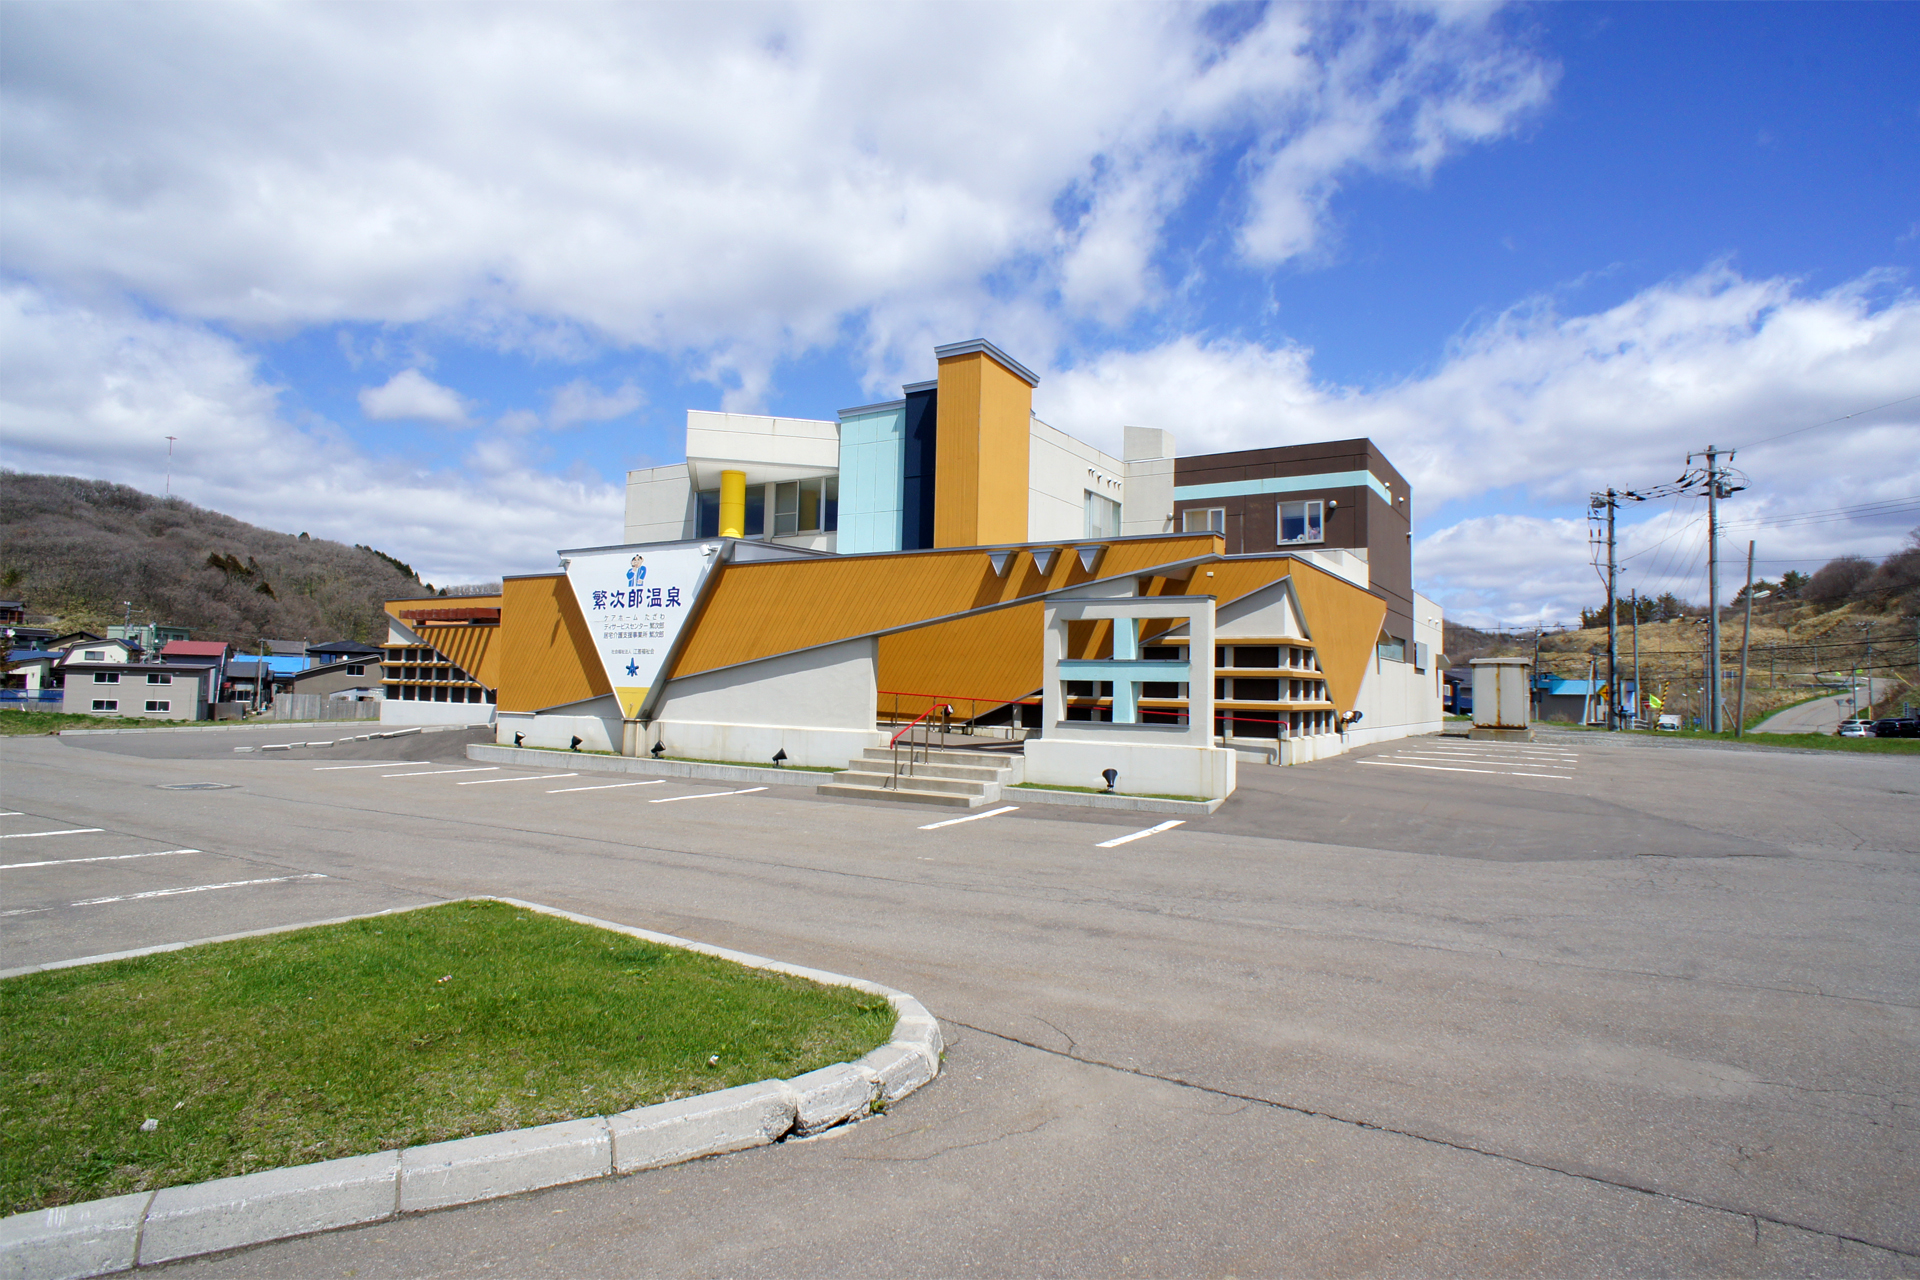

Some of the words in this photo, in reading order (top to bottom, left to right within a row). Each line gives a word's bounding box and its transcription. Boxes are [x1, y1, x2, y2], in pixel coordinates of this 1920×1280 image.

[592, 586, 682, 610] 繁次郎温泉
